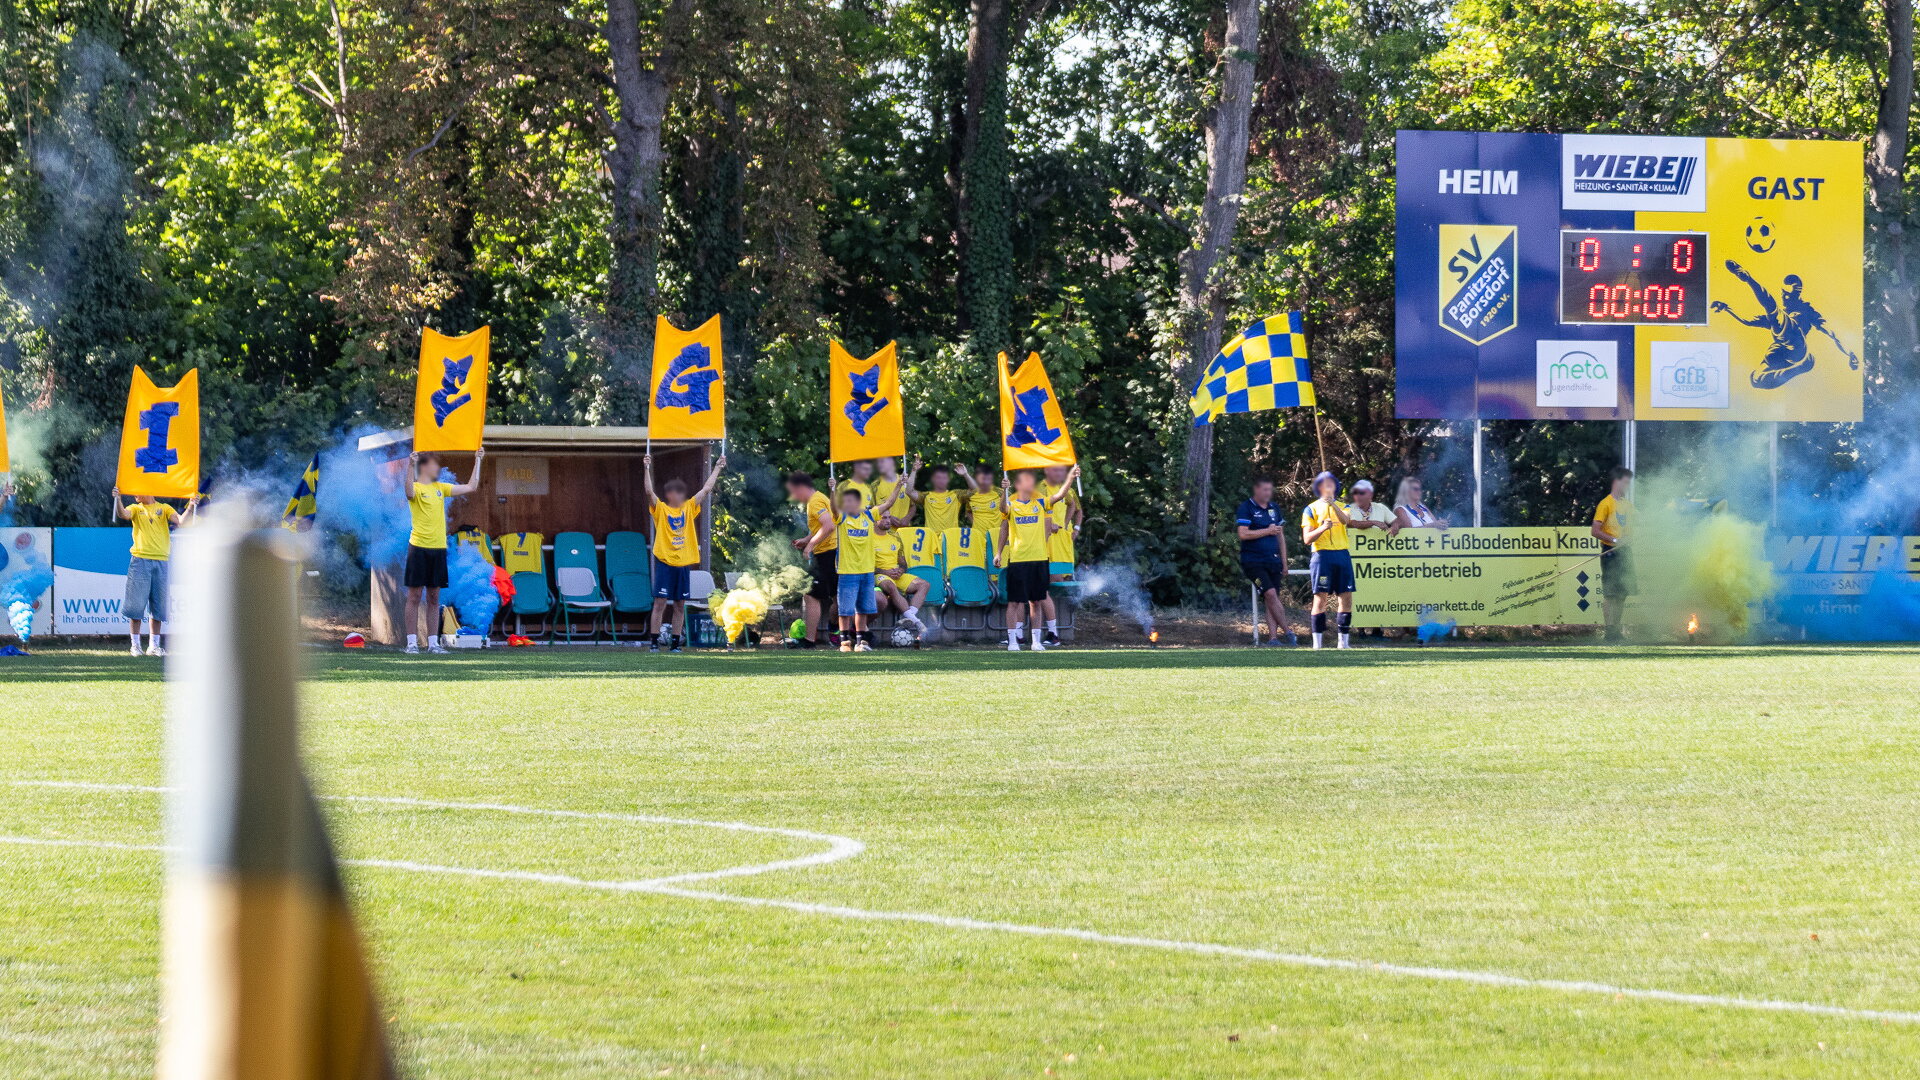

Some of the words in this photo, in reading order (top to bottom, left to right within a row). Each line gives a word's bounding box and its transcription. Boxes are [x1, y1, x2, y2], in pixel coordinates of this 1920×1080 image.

[1574, 154, 1679, 179] WIEBE
[1438, 169, 1518, 195] HEIM
[1574, 182, 1611, 191] HEIZUNG
[1616, 181, 1648, 192] SANITÄR
[1653, 184, 1677, 193] KLIMA
[1748, 176, 1824, 201] GAST
[1448, 233, 1482, 284] SV
[1579, 237, 1600, 273] 0
[1672, 238, 1694, 273] 0
[1448, 256, 1504, 321] Panitzsch
[1459, 266, 1510, 328] Borsdorf
[1588, 283, 1685, 319] 00:00
[1480, 306, 1498, 327] 1920
[655, 342, 719, 415] G
[1550, 359, 1608, 380] meta
[1674, 366, 1706, 385] GfB
[912, 528, 926, 552] 3
[959, 527, 970, 549] 8
[1355, 535, 1420, 550] Parkett
[1425, 536, 1435, 548] +
[1441, 533, 1551, 549] Fußbodenbau
[1557, 533, 1599, 549] Knau
[1355, 562, 1482, 578] Meisterbetrieb
[62, 615, 74, 623] Ihr
[77, 615, 109, 623] Partner
[111, 615, 119, 623] in
[1355, 600, 1485, 614] www.leipzig-parkett.de
